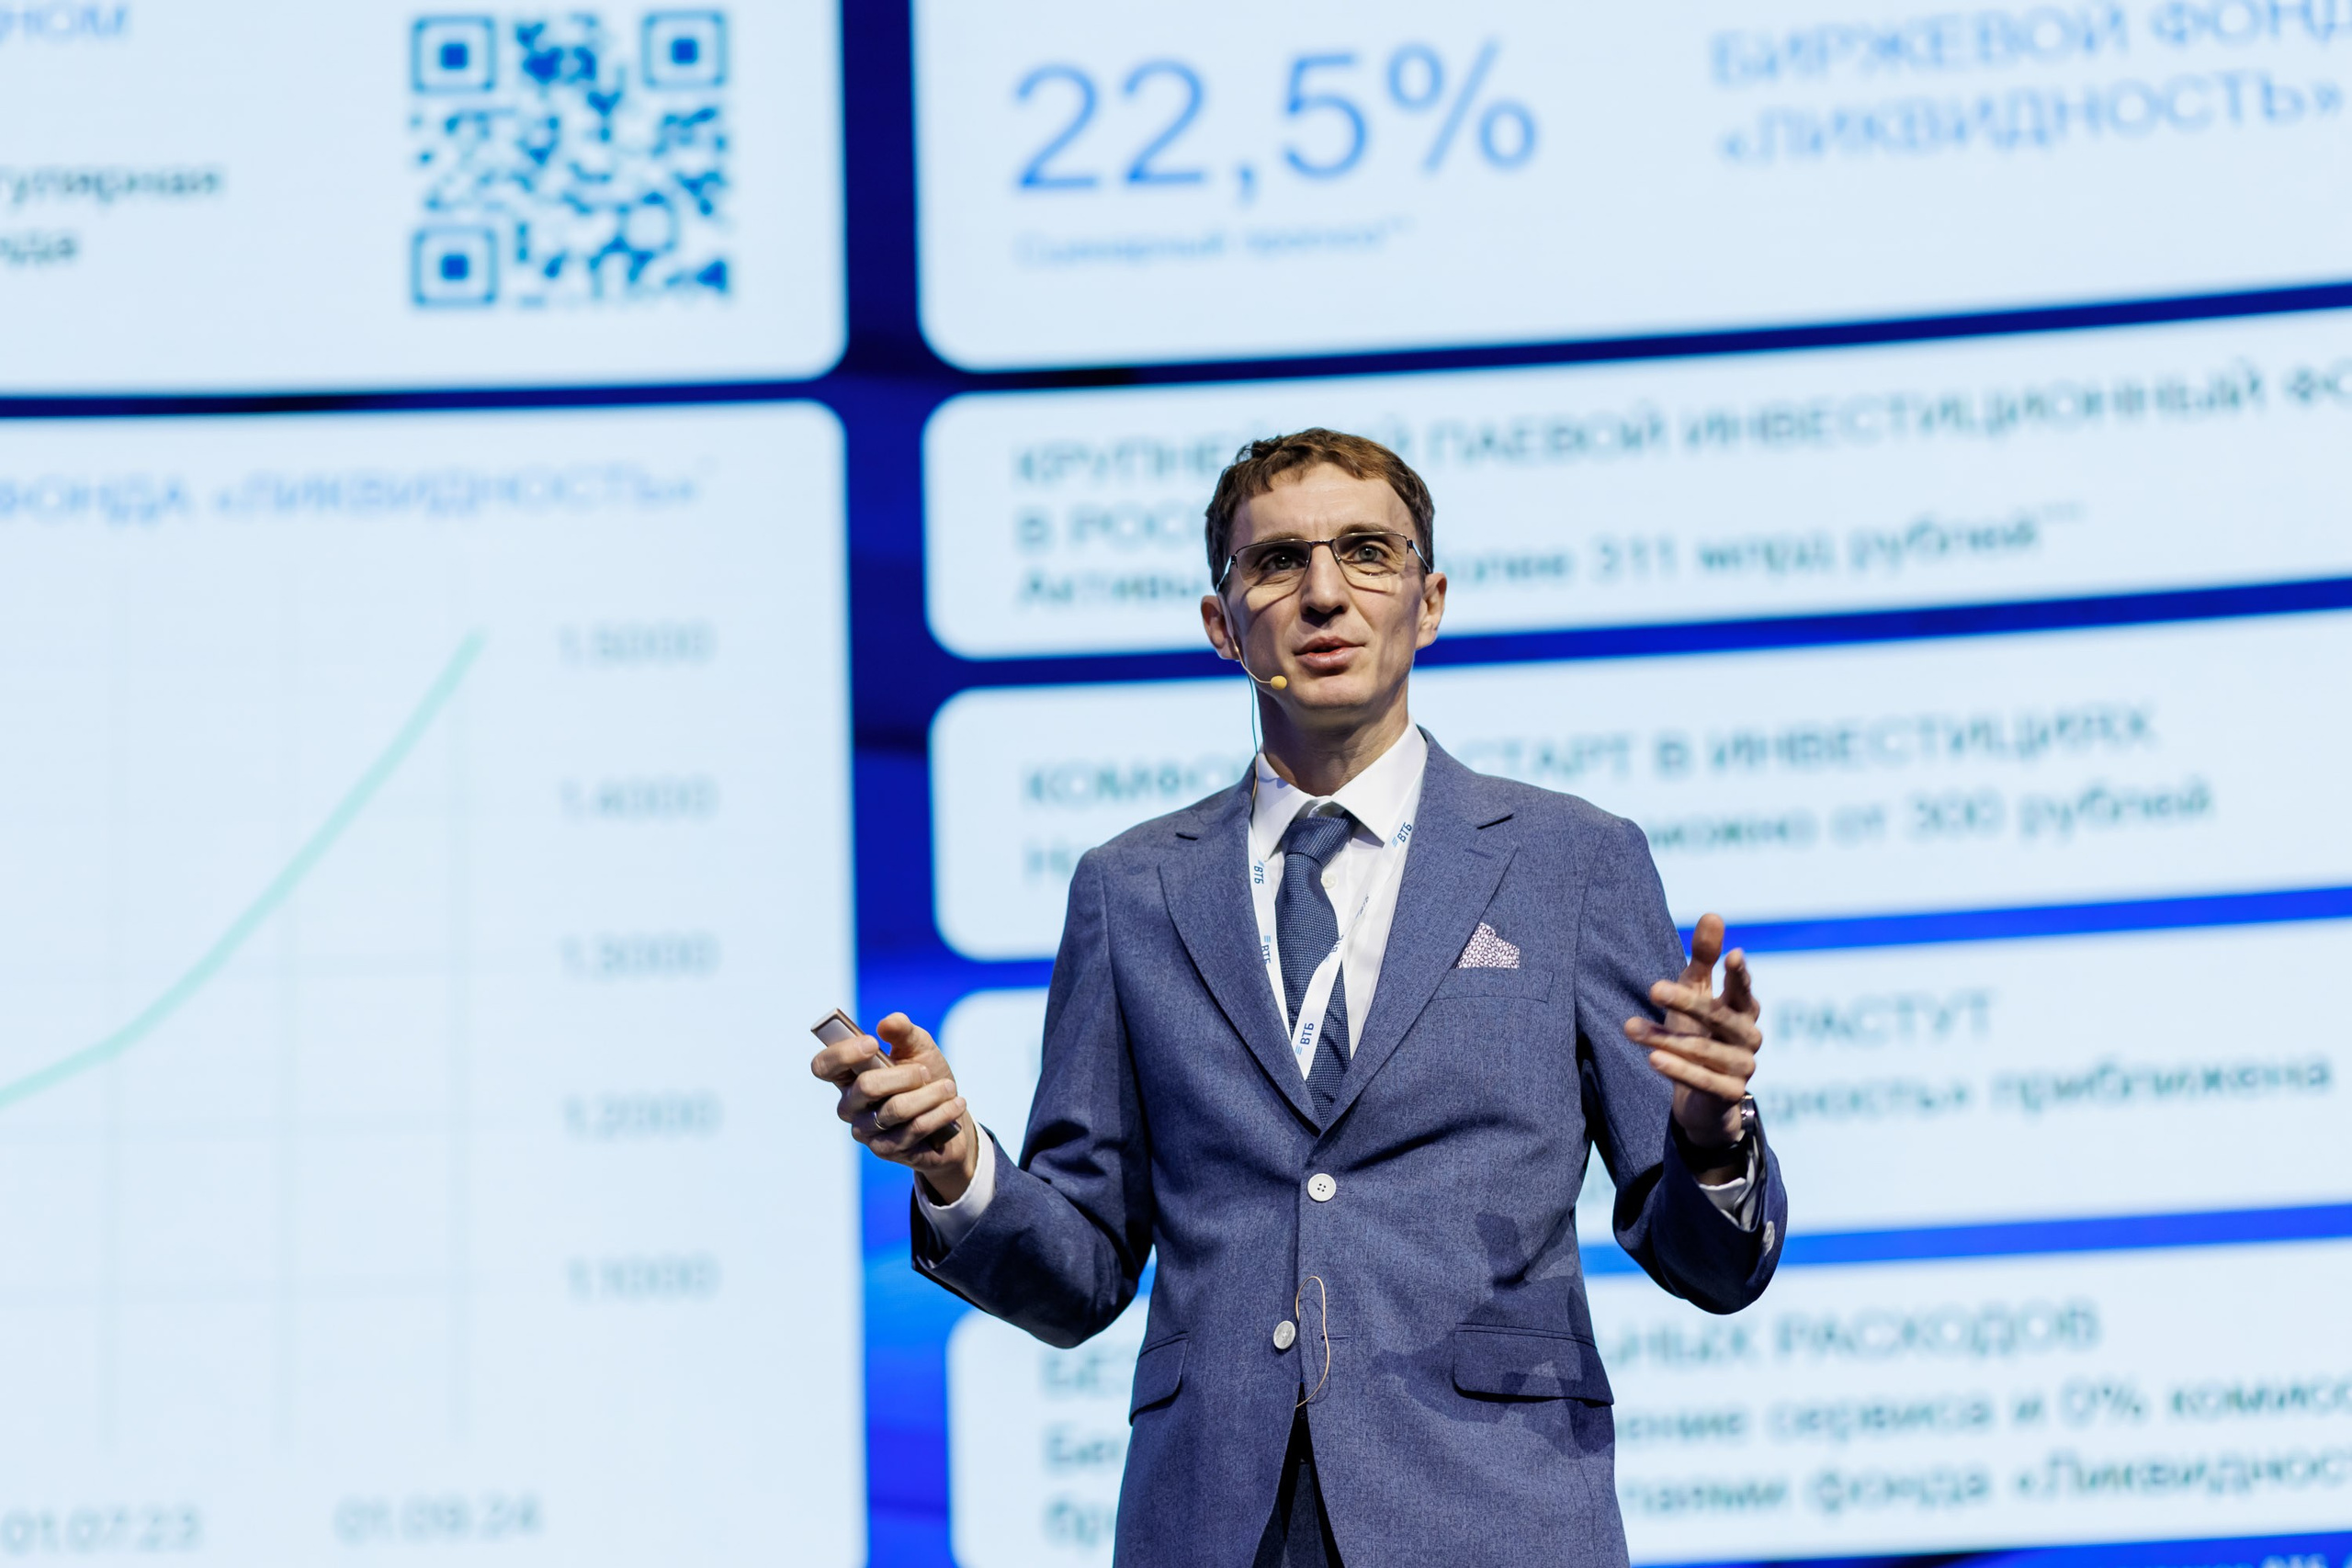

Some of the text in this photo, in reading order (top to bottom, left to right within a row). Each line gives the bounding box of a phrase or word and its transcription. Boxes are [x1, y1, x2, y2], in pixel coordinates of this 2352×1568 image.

[1012, 41, 1540, 203] 22,5%
[1396, 821, 1412, 843] ВТБ
[1253, 865, 1264, 885] ВТБ
[1300, 1022, 1314, 1045] ВТБ
